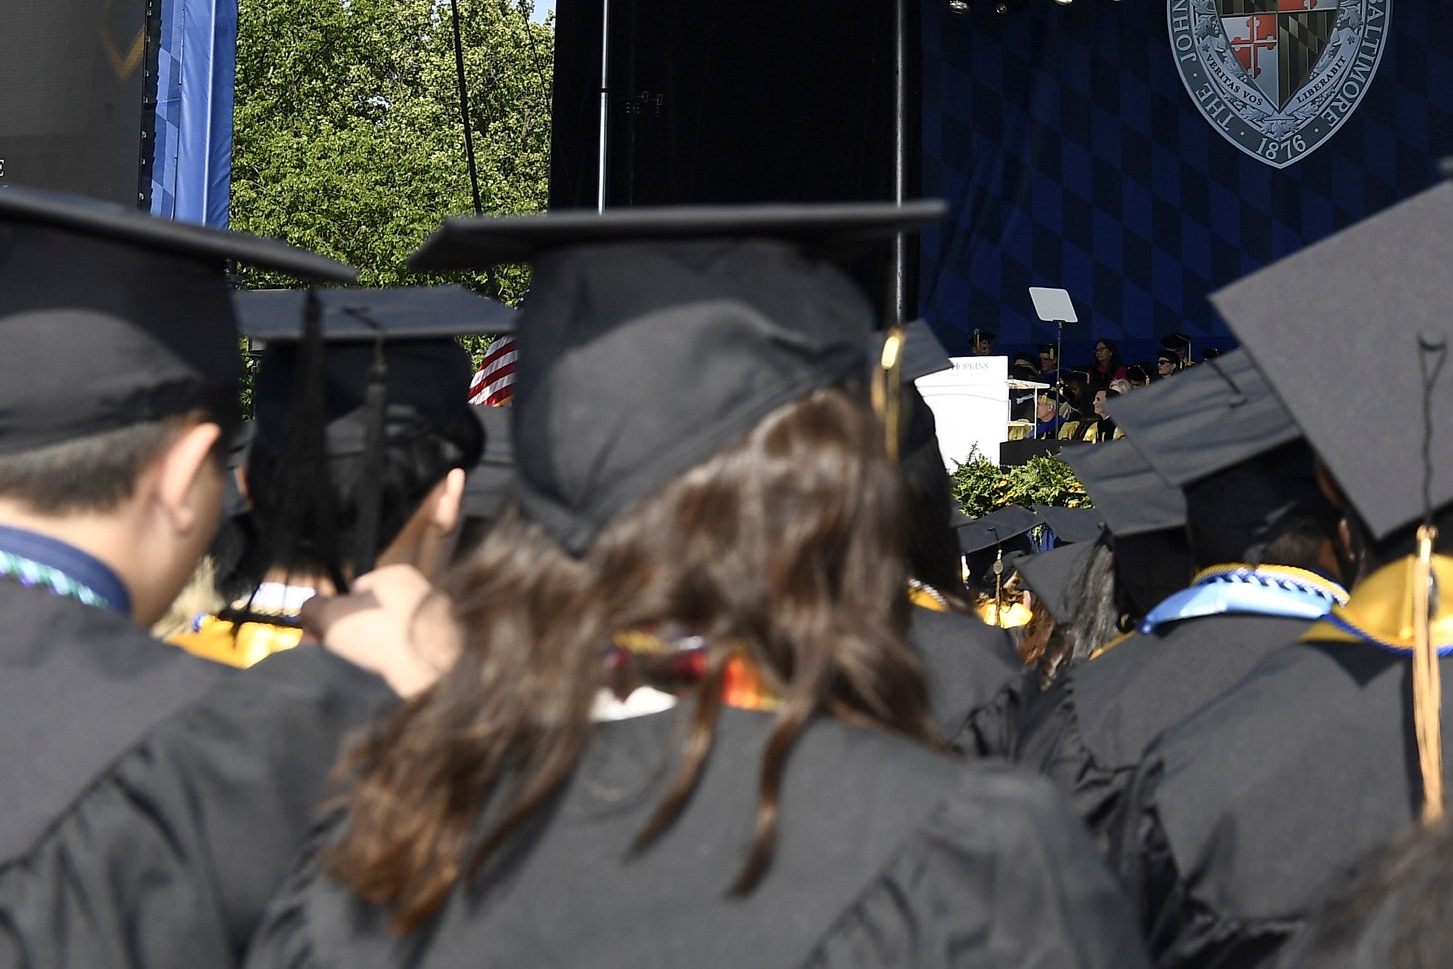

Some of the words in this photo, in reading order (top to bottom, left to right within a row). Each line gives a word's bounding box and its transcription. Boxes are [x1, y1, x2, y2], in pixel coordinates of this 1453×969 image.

[1206, 53, 1242, 93] VERITAS
[1243, 89, 1264, 106] VOS
[1296, 55, 1347, 103] LIBERABIT
[1195, 82, 1235, 131] THE
[1256, 134, 1307, 160] 1876
